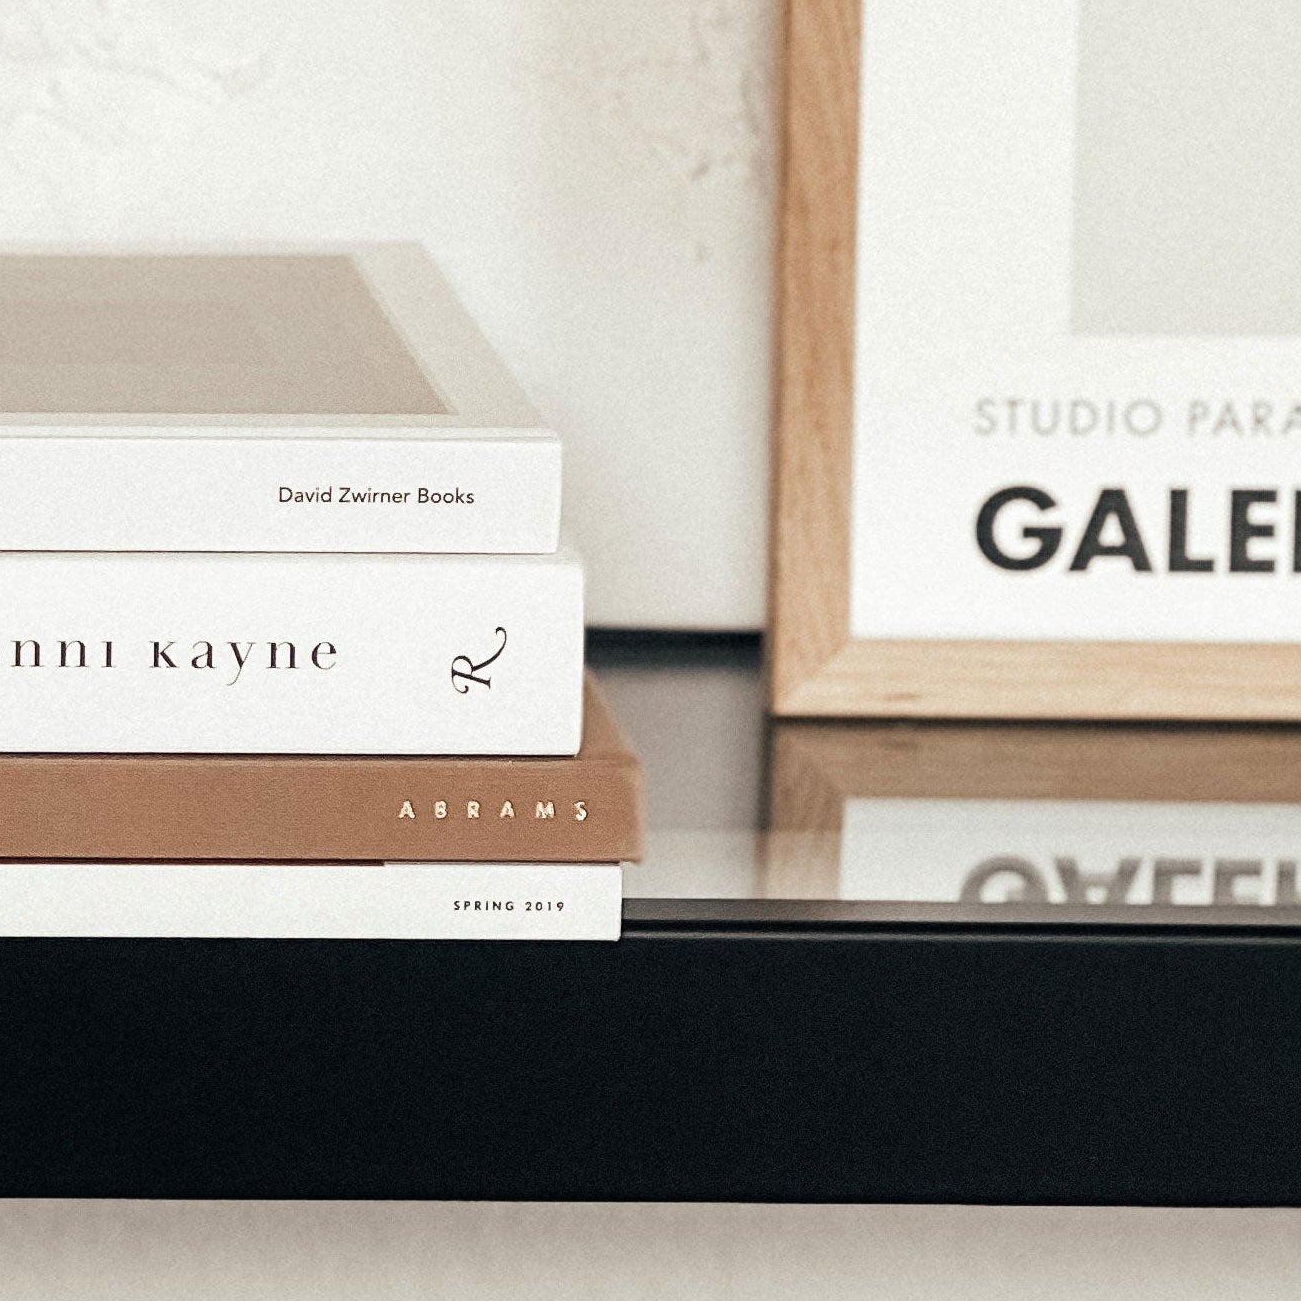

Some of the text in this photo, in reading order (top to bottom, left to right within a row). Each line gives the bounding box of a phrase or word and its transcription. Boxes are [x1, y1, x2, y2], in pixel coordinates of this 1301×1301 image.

[976, 397, 1163, 437] STUDIO
[278, 486, 475, 505] David Zwirner Books
[975, 485, 1301, 573] GALE
[397, 800, 590, 822] ABRAMS
[453, 900, 566, 912] SPRING 2019
